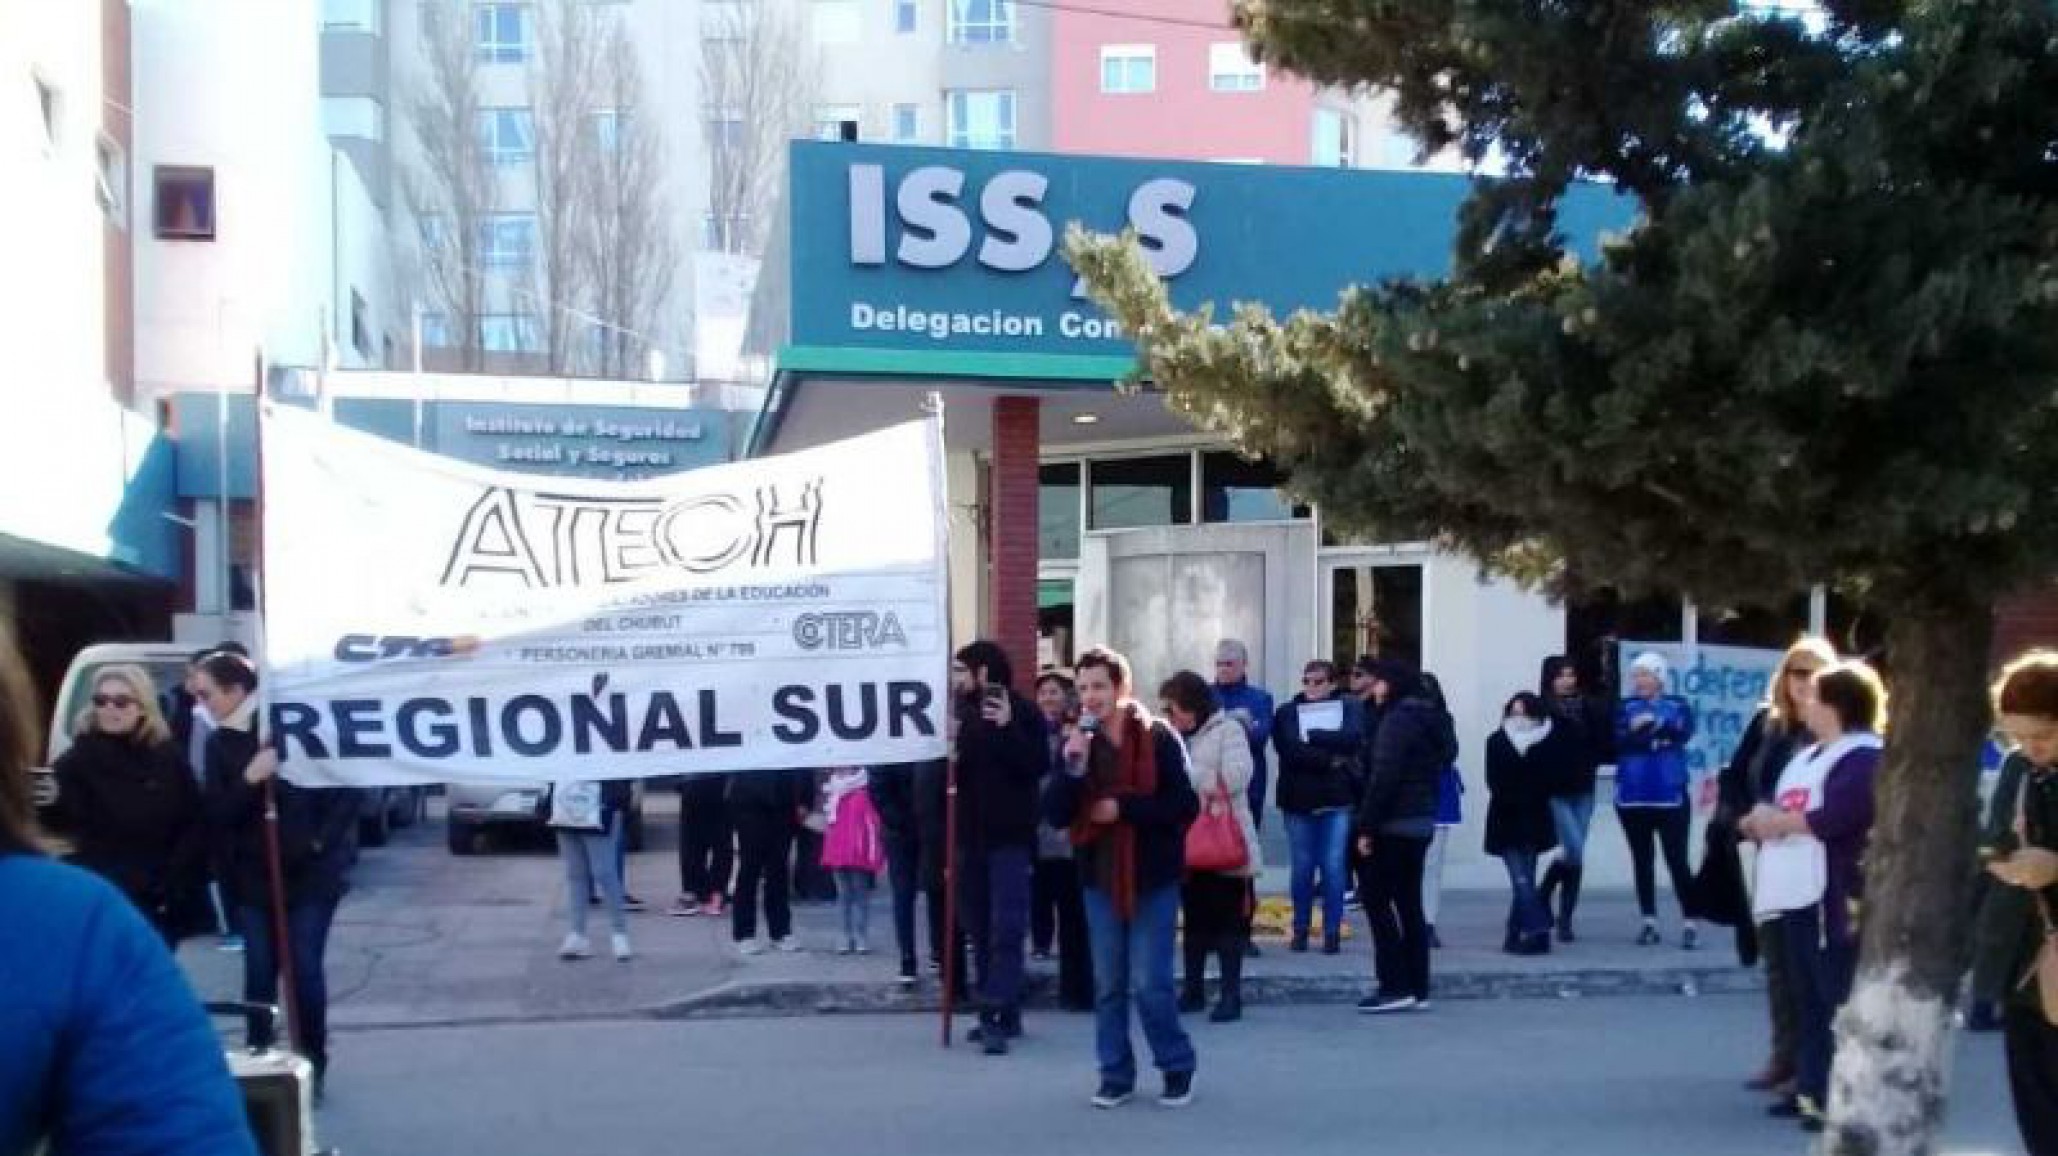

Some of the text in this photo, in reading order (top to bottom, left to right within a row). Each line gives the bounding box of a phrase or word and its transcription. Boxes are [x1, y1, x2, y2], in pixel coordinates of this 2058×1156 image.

[851, 303, 1042, 336] Delegacion
[466, 414, 702, 440] Instituto de Seguridad
[497, 442, 561, 460] Social
[587, 445, 671, 467] Seguros
[440, 476, 823, 587] ATECH
[717, 586, 737, 600] LA
[270, 681, 935, 762] REGIONAL SUR
